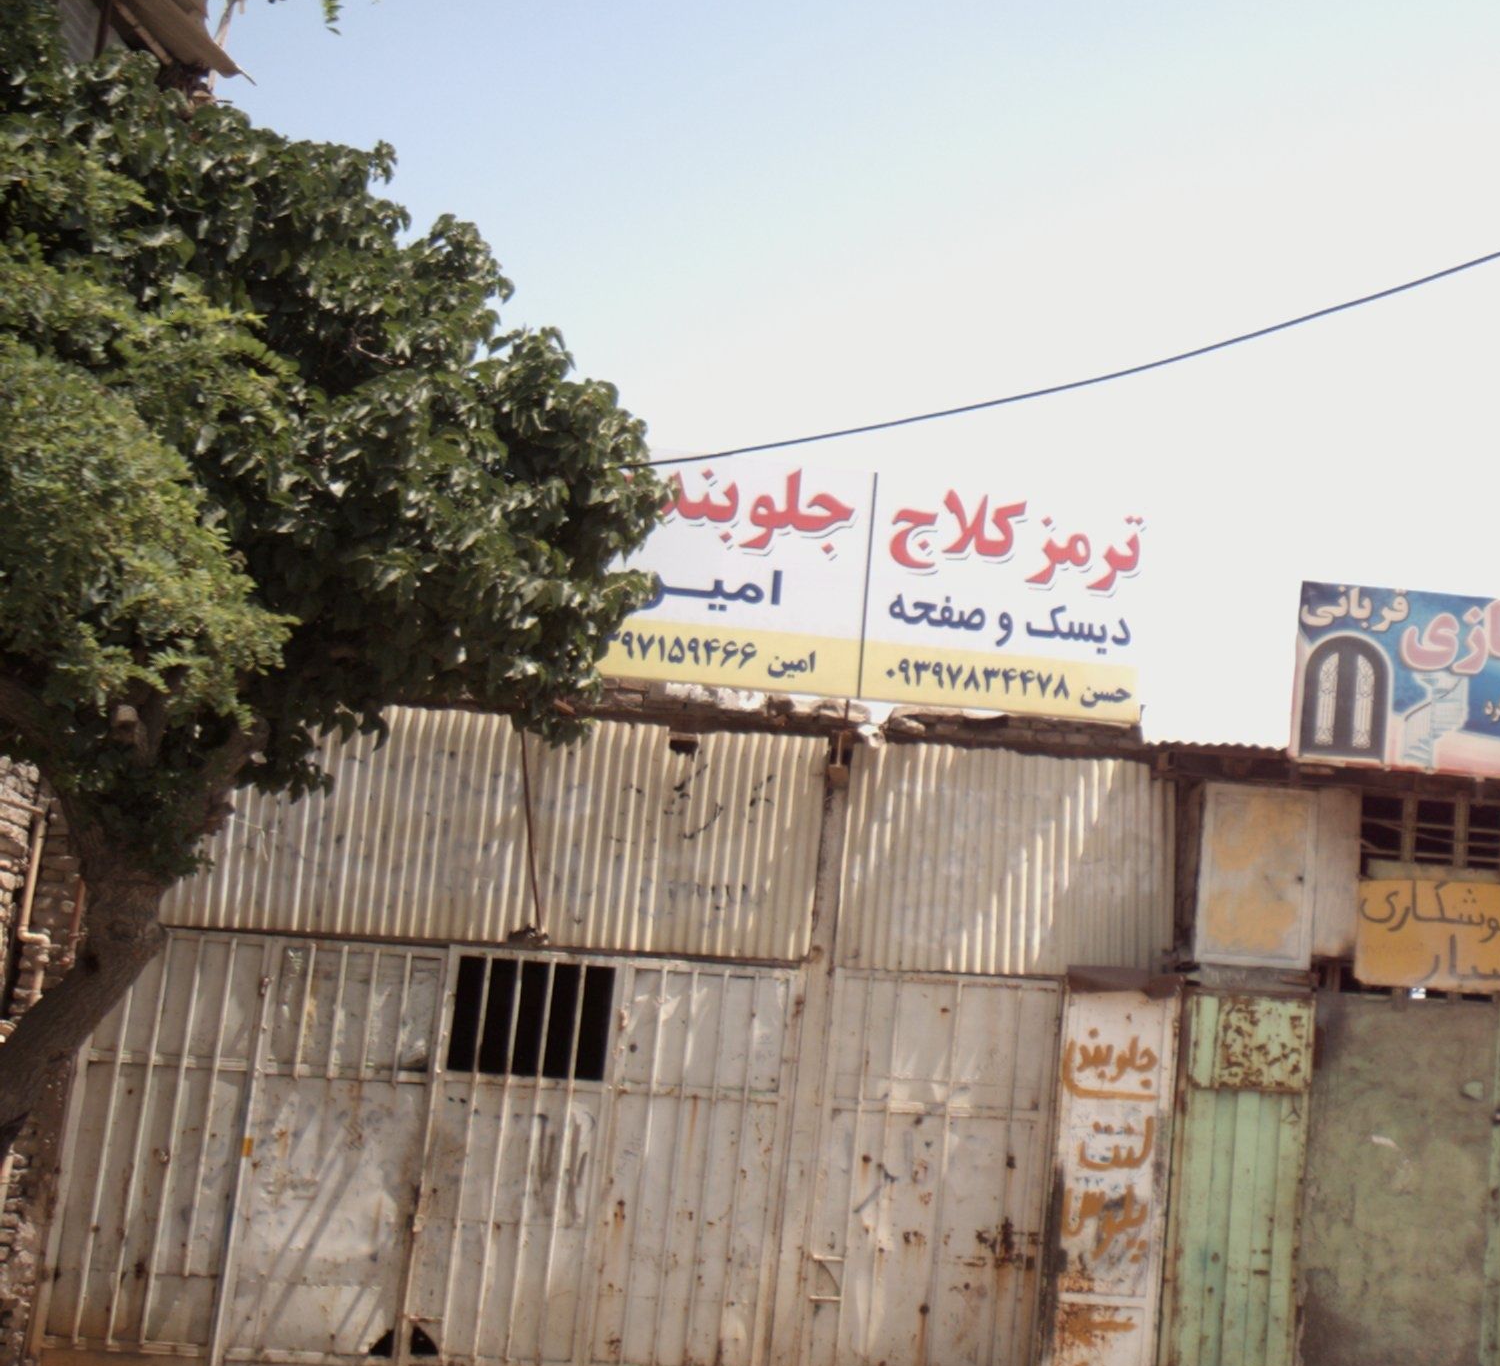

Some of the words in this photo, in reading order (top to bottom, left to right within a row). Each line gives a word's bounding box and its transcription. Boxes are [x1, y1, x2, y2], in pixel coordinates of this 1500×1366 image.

[626, 468, 856, 556] جلوبند
[888, 487, 1028, 569] کلاج
[1025, 513, 1144, 592] ترمز
[889, 593, 987, 632] صفحه
[995, 611, 1014, 647] و
[1026, 605, 1132, 655] دیسک
[1300, 586, 1409, 633] قربانی
[767, 650, 816, 678] امین
[885, 657, 1070, 701] ۰۹۳۹۷۸۳۴۴۷۸
[1079, 686, 1133, 708] حسن
[1061, 1027, 1160, 1102] جلوبندی
[1077, 1115, 1154, 1171] لنت
[1060, 1184, 1149, 1264] پلوس
